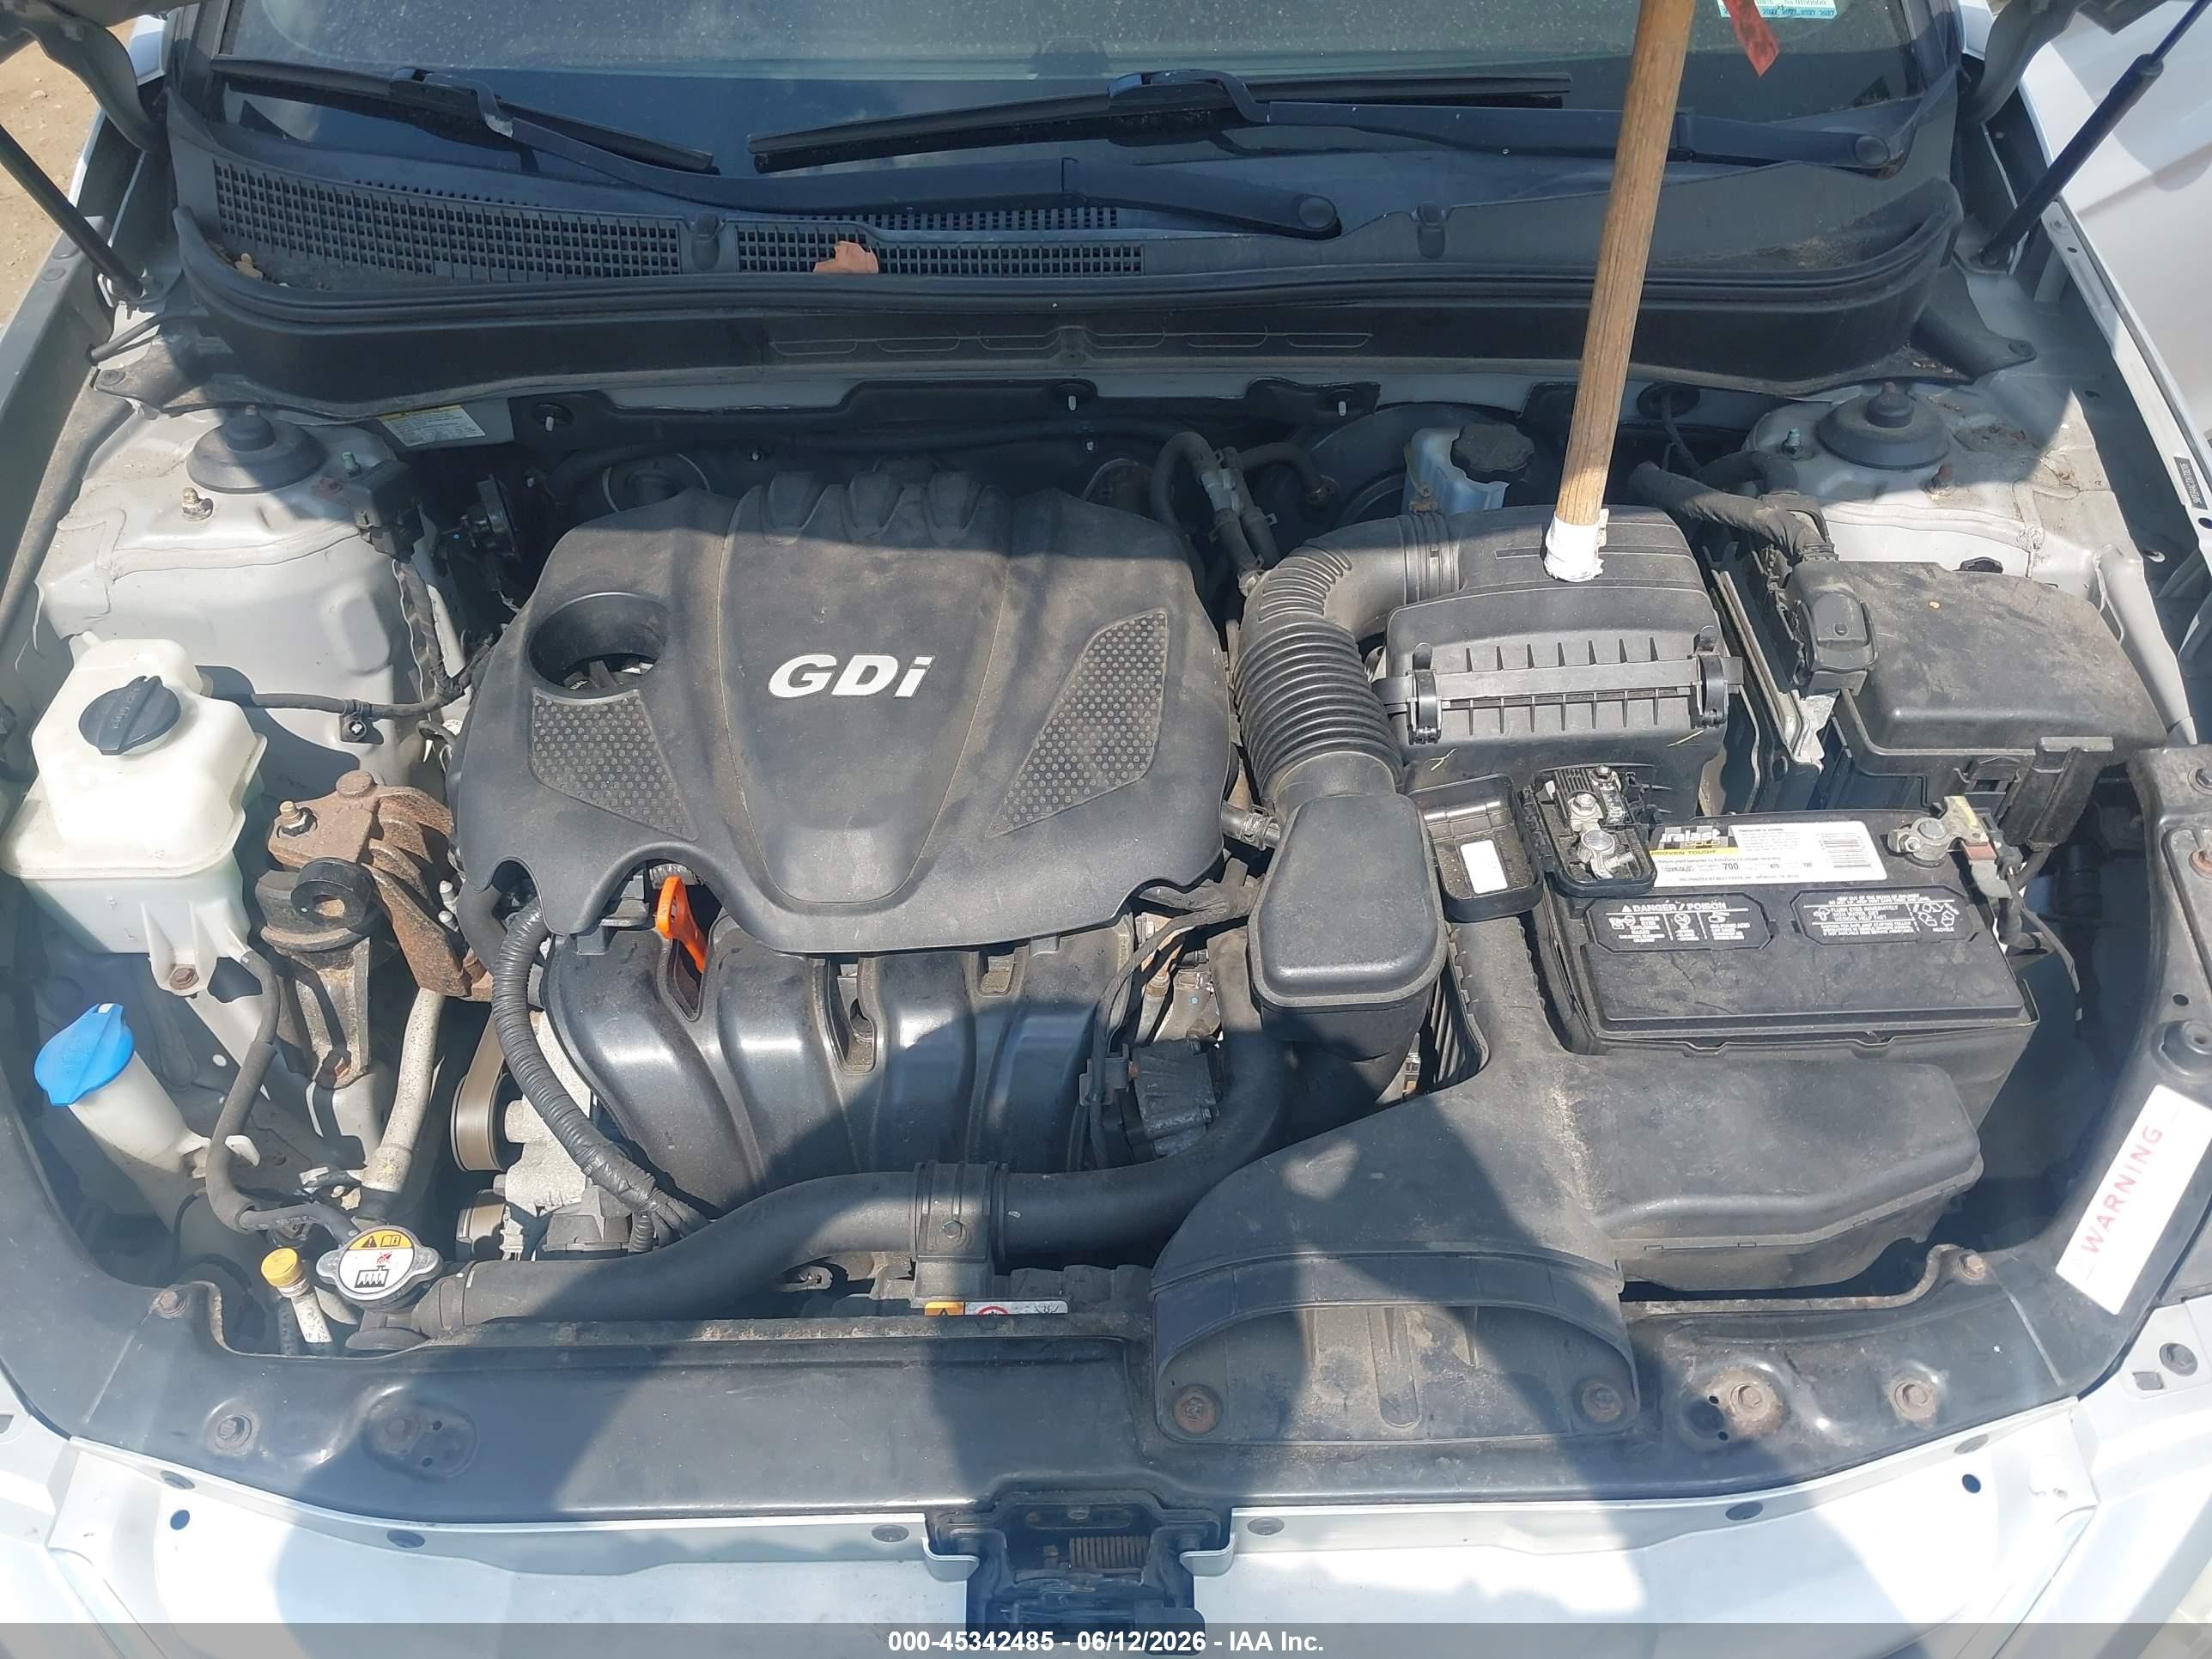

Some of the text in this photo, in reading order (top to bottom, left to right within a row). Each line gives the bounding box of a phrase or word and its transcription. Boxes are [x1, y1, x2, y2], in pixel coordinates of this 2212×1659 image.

[768, 653, 935, 698] GDi
[1723, 862, 1739, 871] 700
[1632, 903, 1677, 912] DANGER
[1686, 902, 1727, 910] POISON
[2081, 1126, 2163, 1254] WARNING
